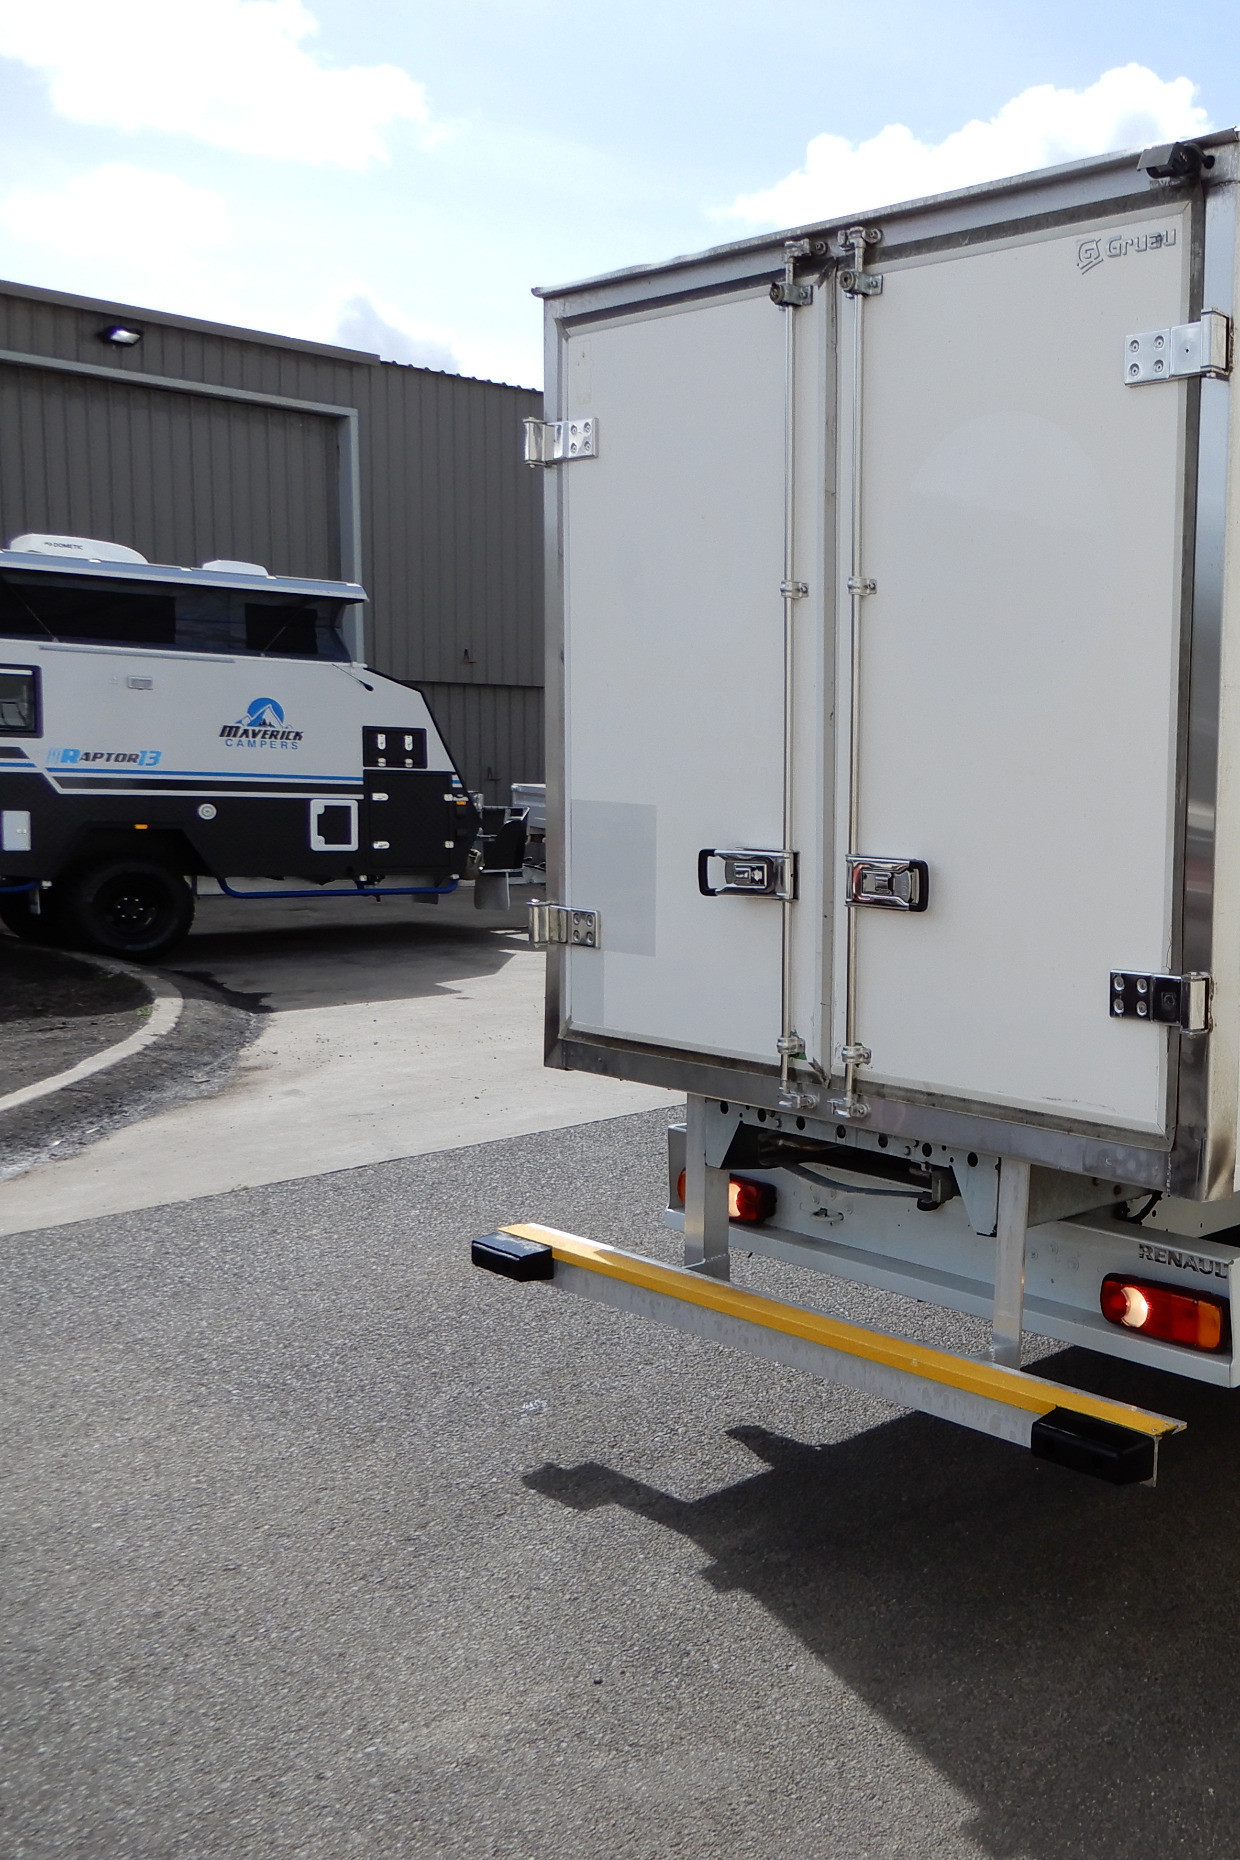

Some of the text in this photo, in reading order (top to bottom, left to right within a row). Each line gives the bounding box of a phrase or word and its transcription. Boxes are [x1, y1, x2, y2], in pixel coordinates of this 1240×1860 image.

[219, 724, 304, 742] MAVERICK
[225, 738, 299, 750] CAMPERS
[1138, 1243, 1229, 1279] RENAUL
